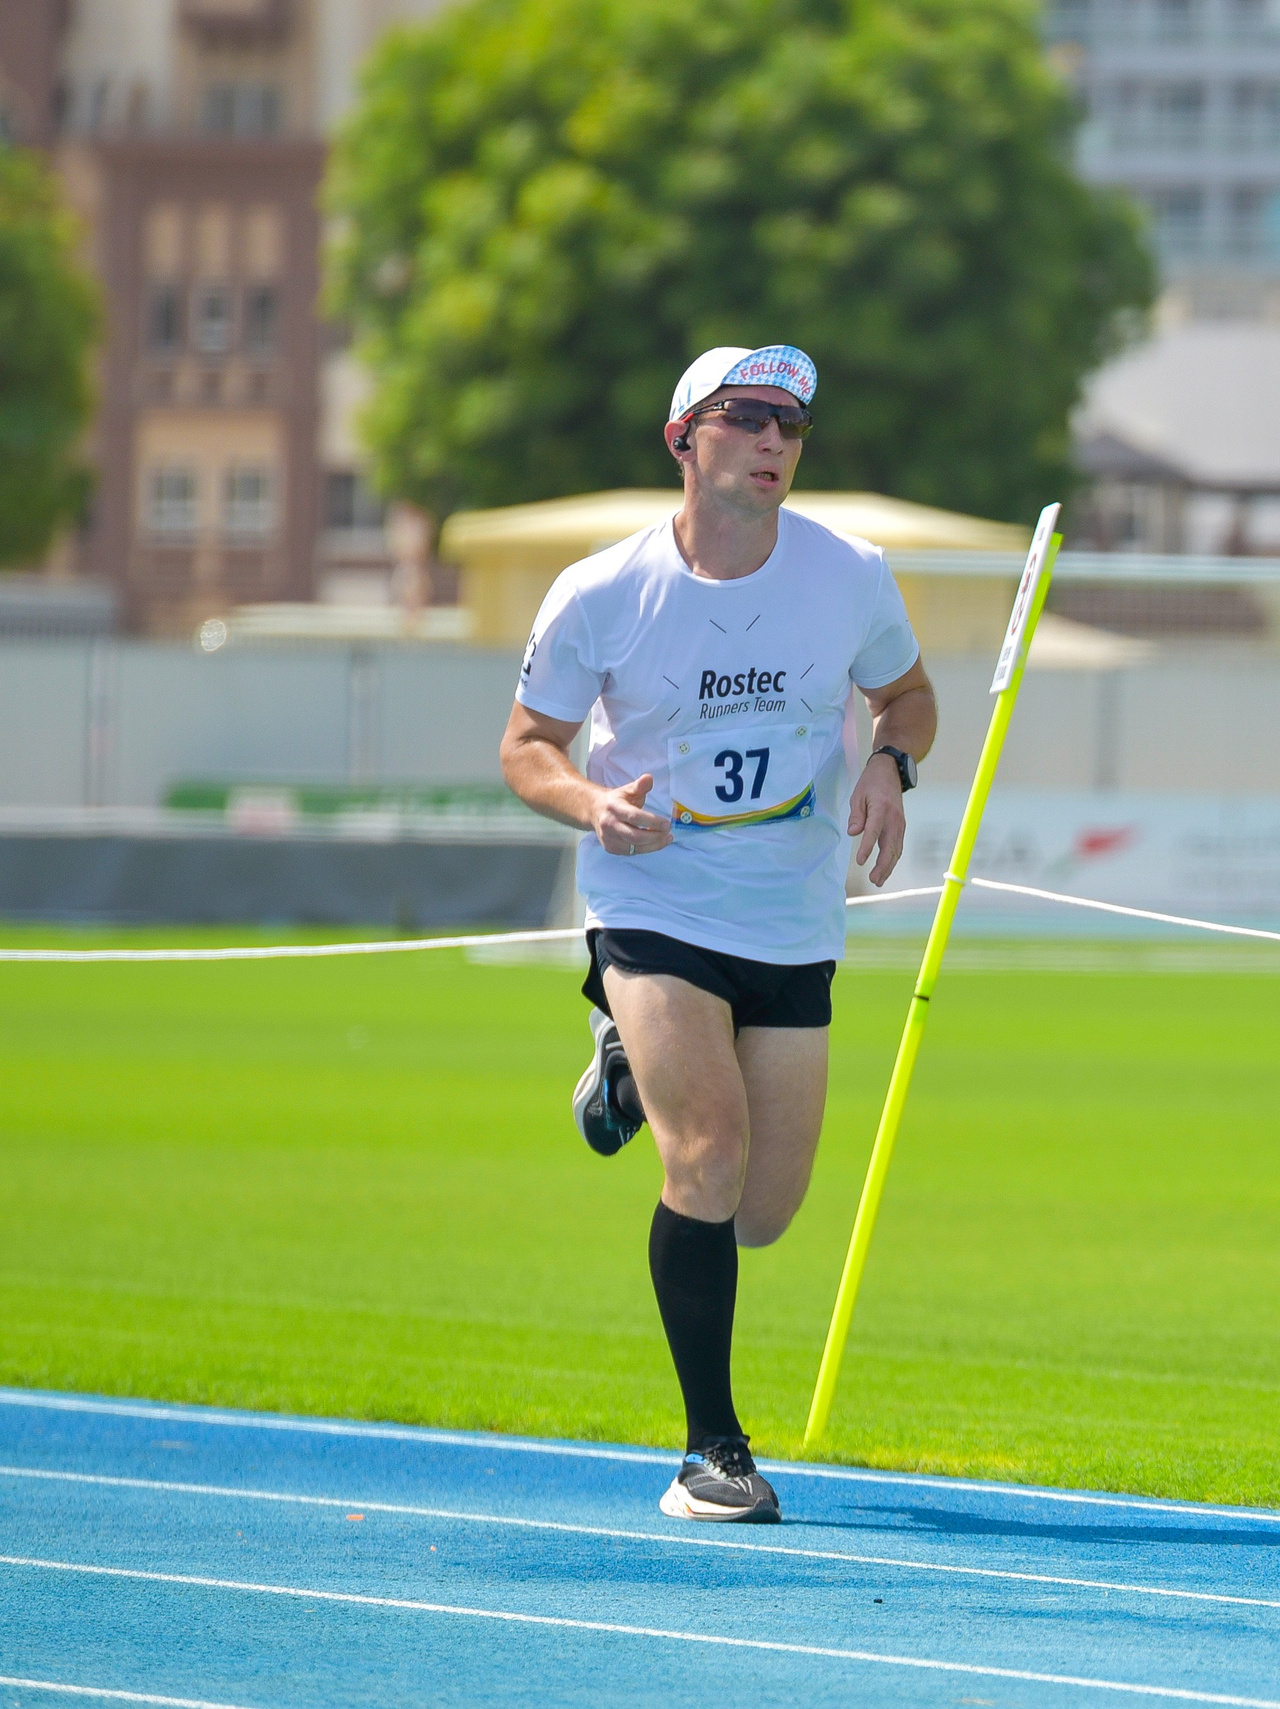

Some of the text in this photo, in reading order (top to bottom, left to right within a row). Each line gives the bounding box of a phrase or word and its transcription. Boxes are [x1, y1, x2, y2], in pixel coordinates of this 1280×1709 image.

[739, 361, 811, 396] FOLLOW ME
[699, 667, 787, 699] Rostec
[699, 699, 786, 719] Runners Team
[714, 747, 770, 803] 37
